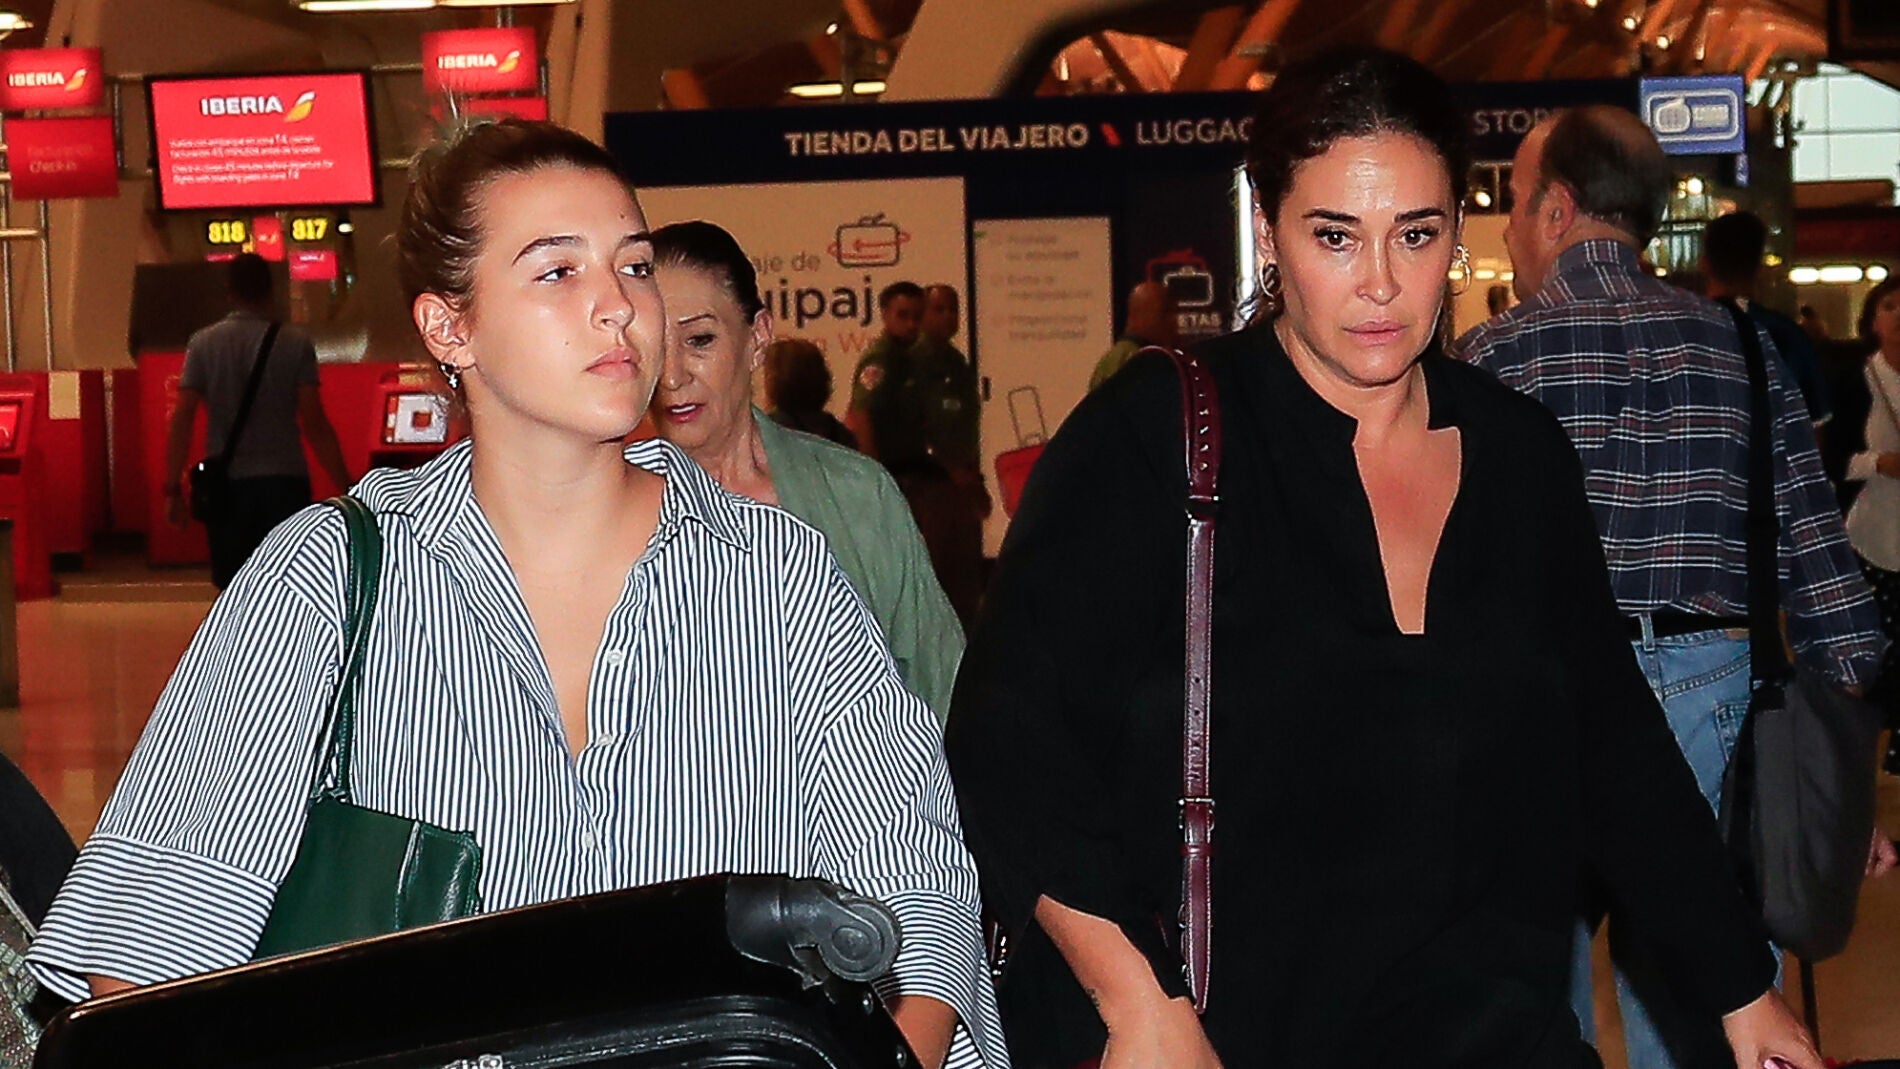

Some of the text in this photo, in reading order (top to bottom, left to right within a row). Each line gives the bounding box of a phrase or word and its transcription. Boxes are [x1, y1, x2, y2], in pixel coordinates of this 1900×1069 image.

[438, 53, 497, 69] IBERIA
[8, 71, 65, 87] IBERIA
[201, 96, 283, 115] IBERIA
[786, 129, 892, 157] TIENDA
[900, 128, 955, 153] DEL
[960, 123, 1089, 150] VIAJERO
[208, 220, 246, 243] 818
[292, 217, 328, 240] 817
[791, 250, 821, 272] de
